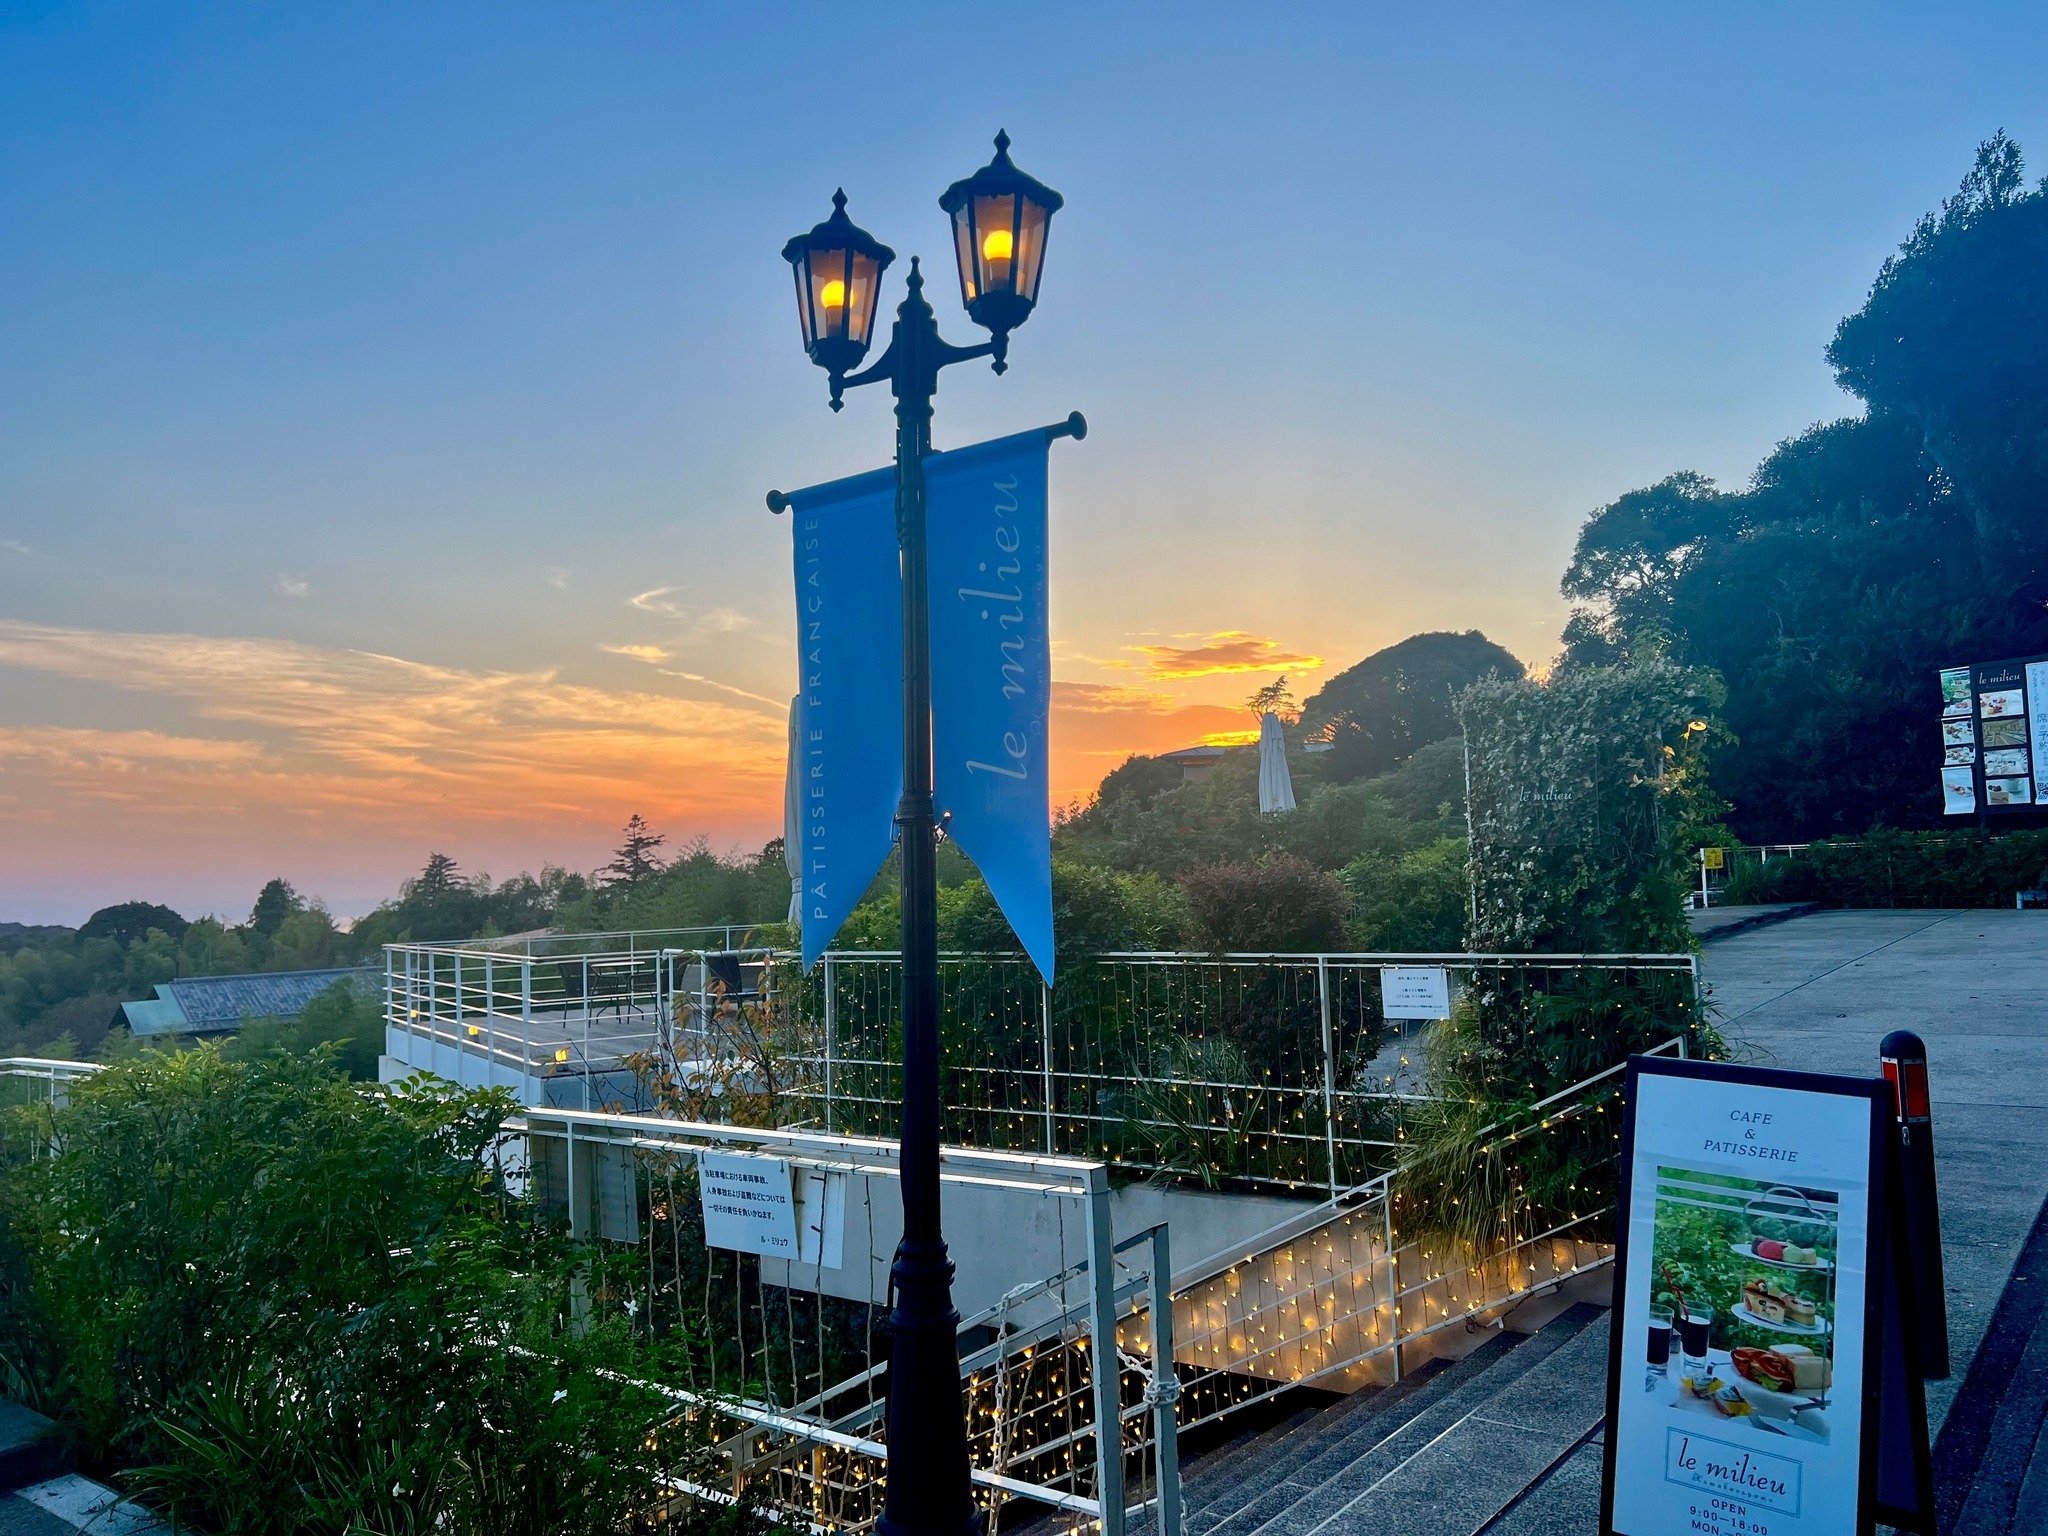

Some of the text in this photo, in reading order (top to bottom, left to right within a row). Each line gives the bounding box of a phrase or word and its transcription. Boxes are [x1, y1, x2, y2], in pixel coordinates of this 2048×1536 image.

[957, 472, 1029, 781] le milieu
[804, 517, 828, 921] PÂTISSERIE FRANÇAISE
[1533, 785, 1573, 801] milieu
[1730, 1110, 1773, 1125] CAFE
[1744, 1128, 1757, 1140] &
[1703, 1140, 1799, 1162] PATISSERIE
[1678, 1437, 1786, 1496] le milieu
[1711, 1498, 1747, 1516] OPEN
